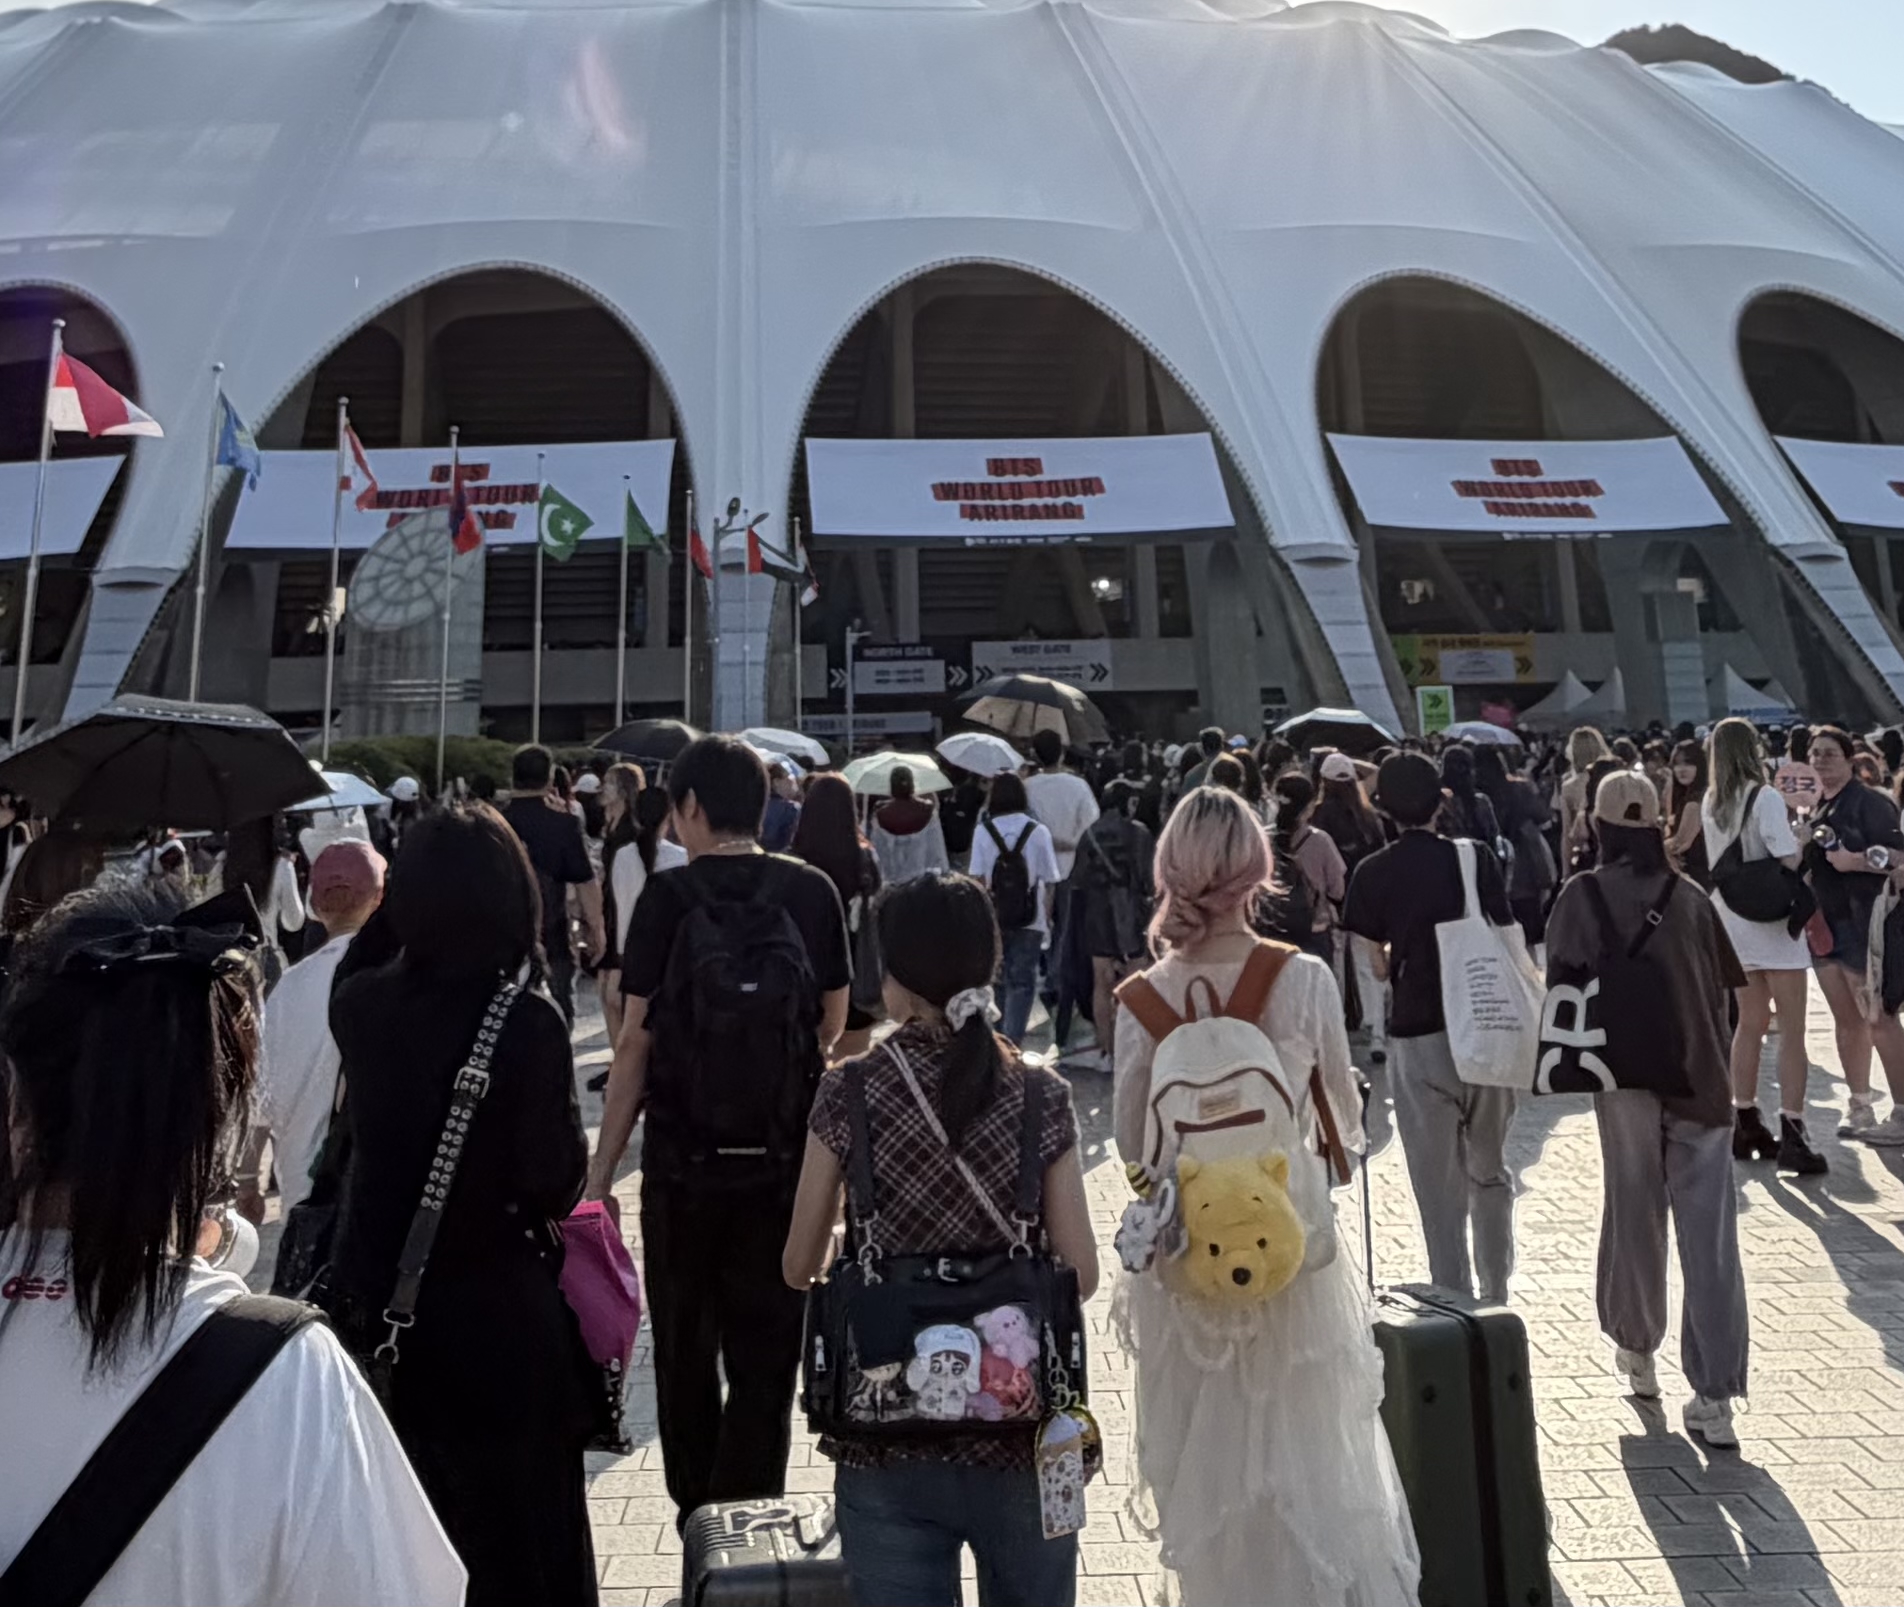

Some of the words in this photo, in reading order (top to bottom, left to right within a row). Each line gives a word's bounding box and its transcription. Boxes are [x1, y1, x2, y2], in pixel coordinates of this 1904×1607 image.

[992, 457, 1038, 477] BTS
[939, 482, 1025, 501] WORLD
[1033, 478, 1097, 498] TOUR
[967, 502, 1078, 521] ARIRANG
[863, 648, 903, 658] NORTH
[904, 646, 934, 656] GATE
[1011, 645, 1043, 655] WEST
[1044, 644, 1071, 654] GATE
